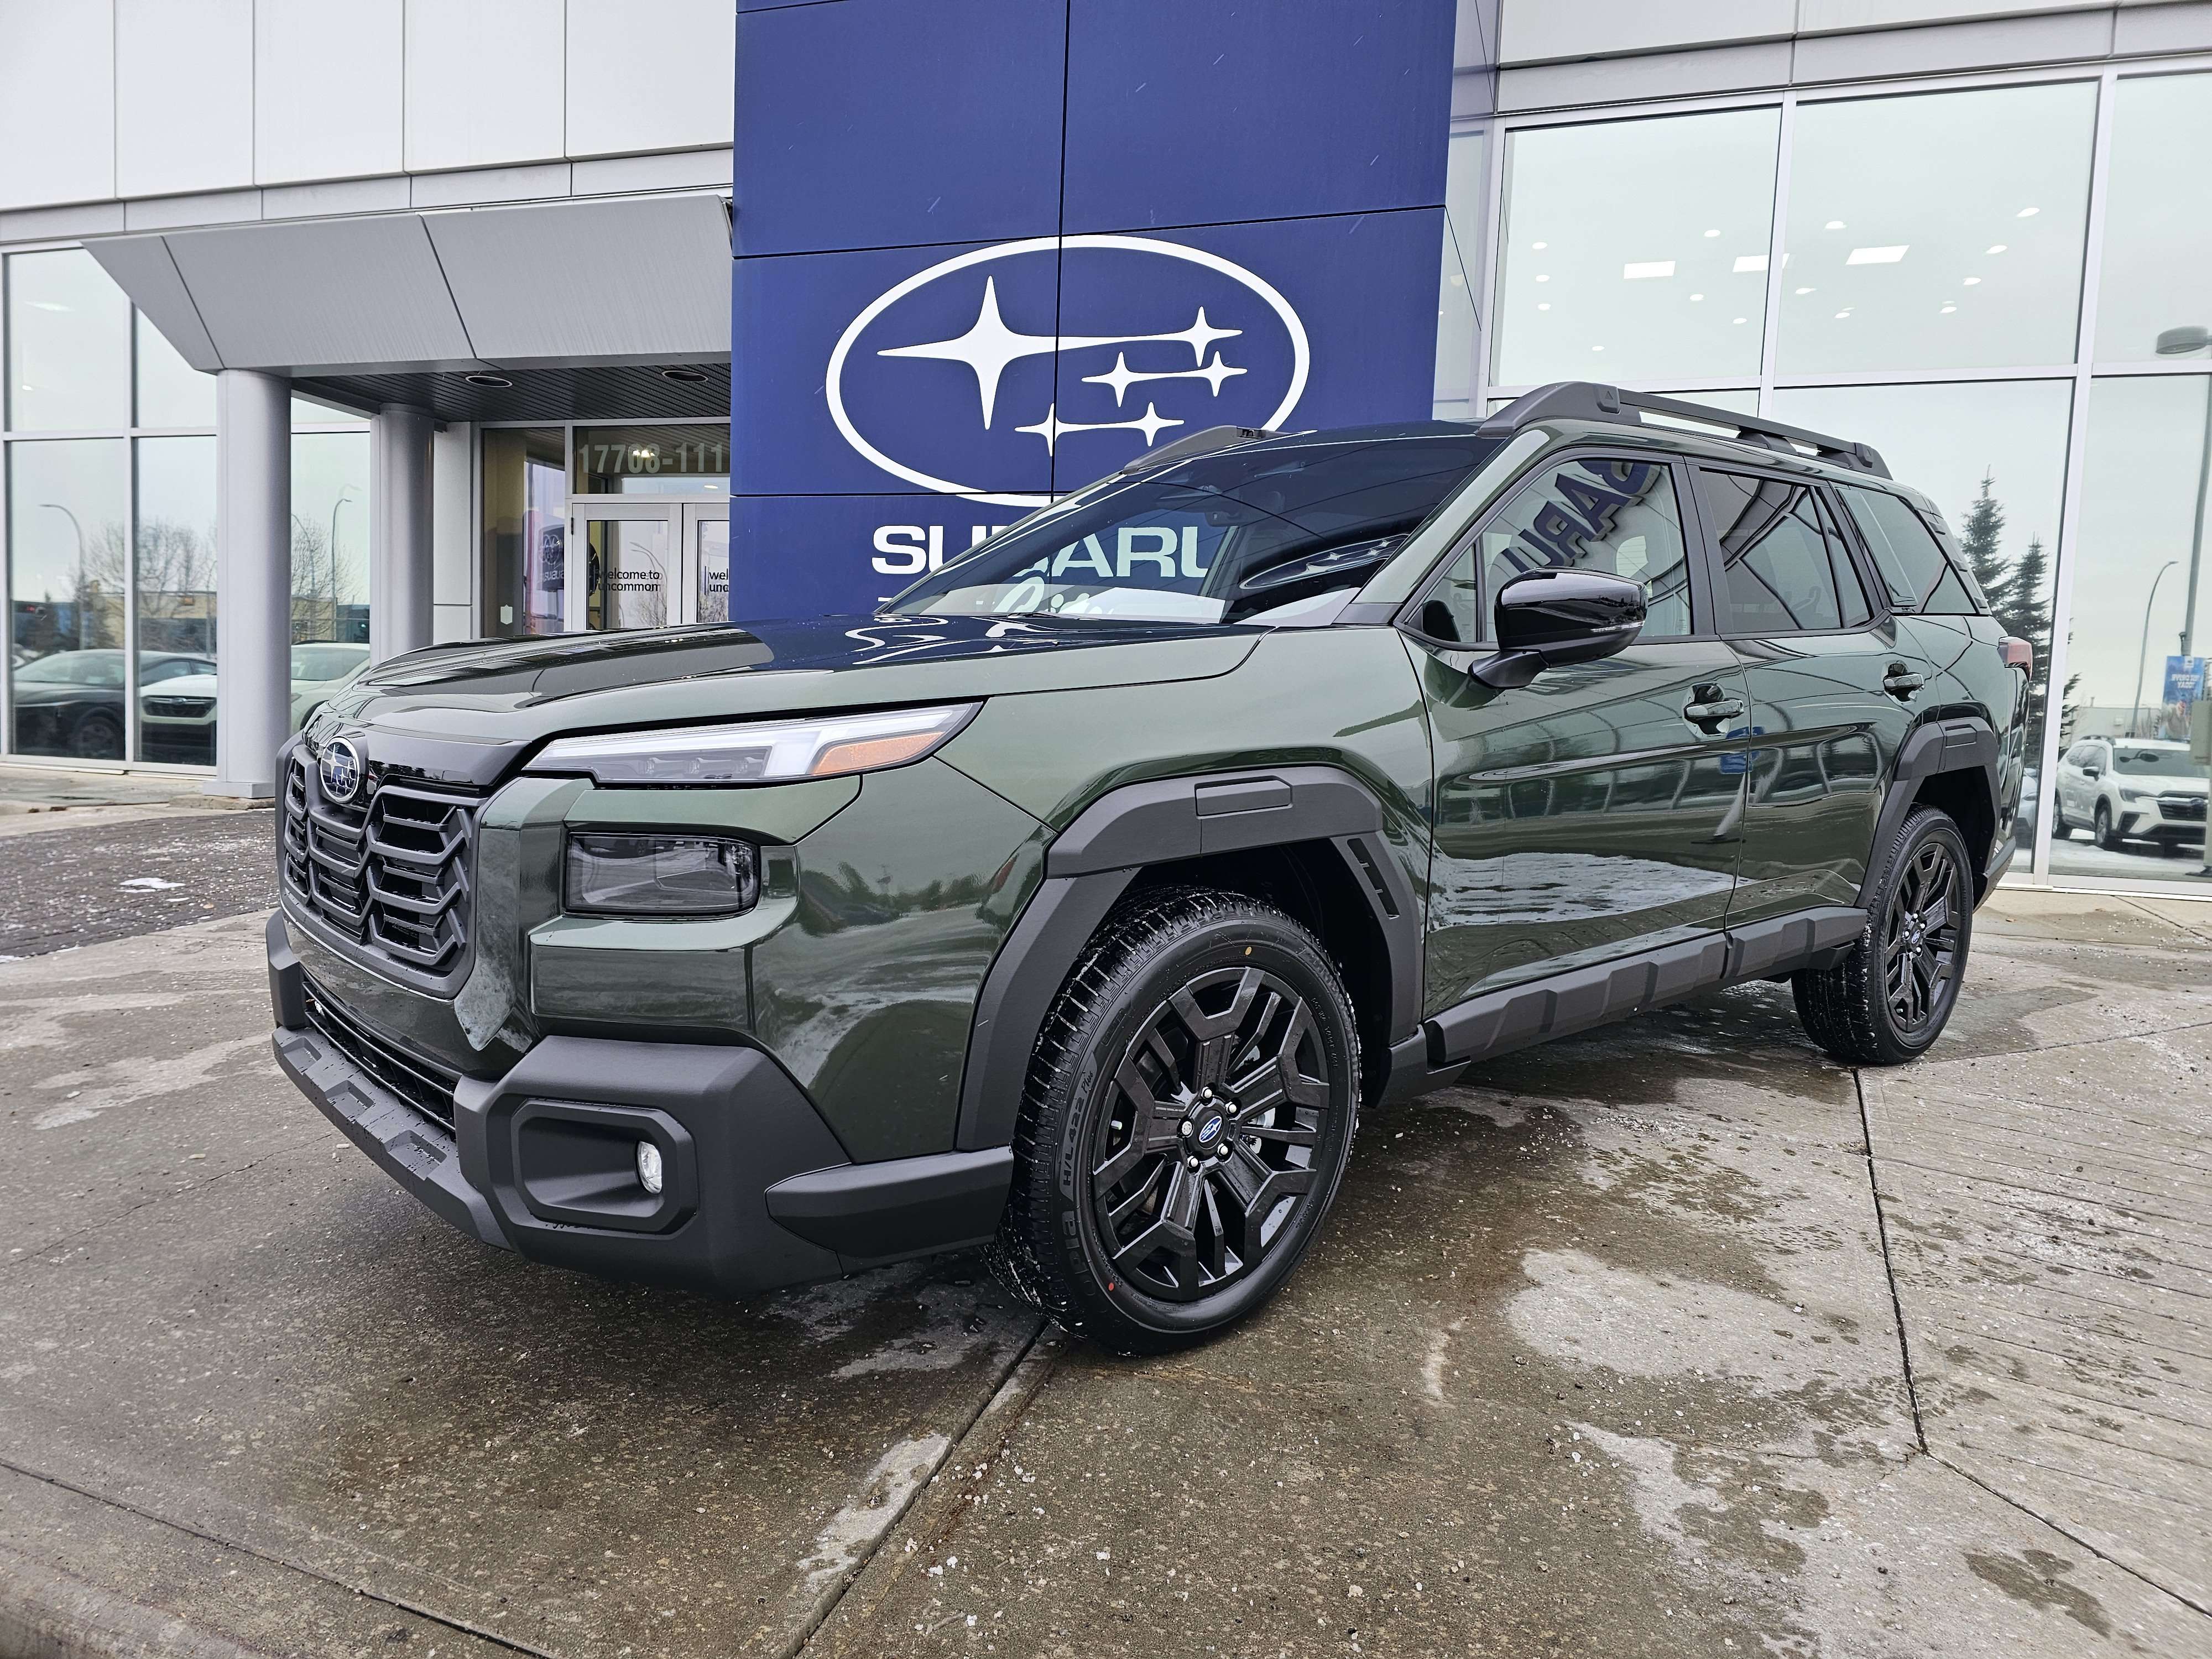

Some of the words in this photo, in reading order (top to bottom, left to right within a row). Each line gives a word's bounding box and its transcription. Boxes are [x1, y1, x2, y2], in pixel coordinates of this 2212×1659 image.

[872, 525, 1212, 578] SUARU
[598, 567, 646, 580] elcome
[649, 570, 660, 580] to
